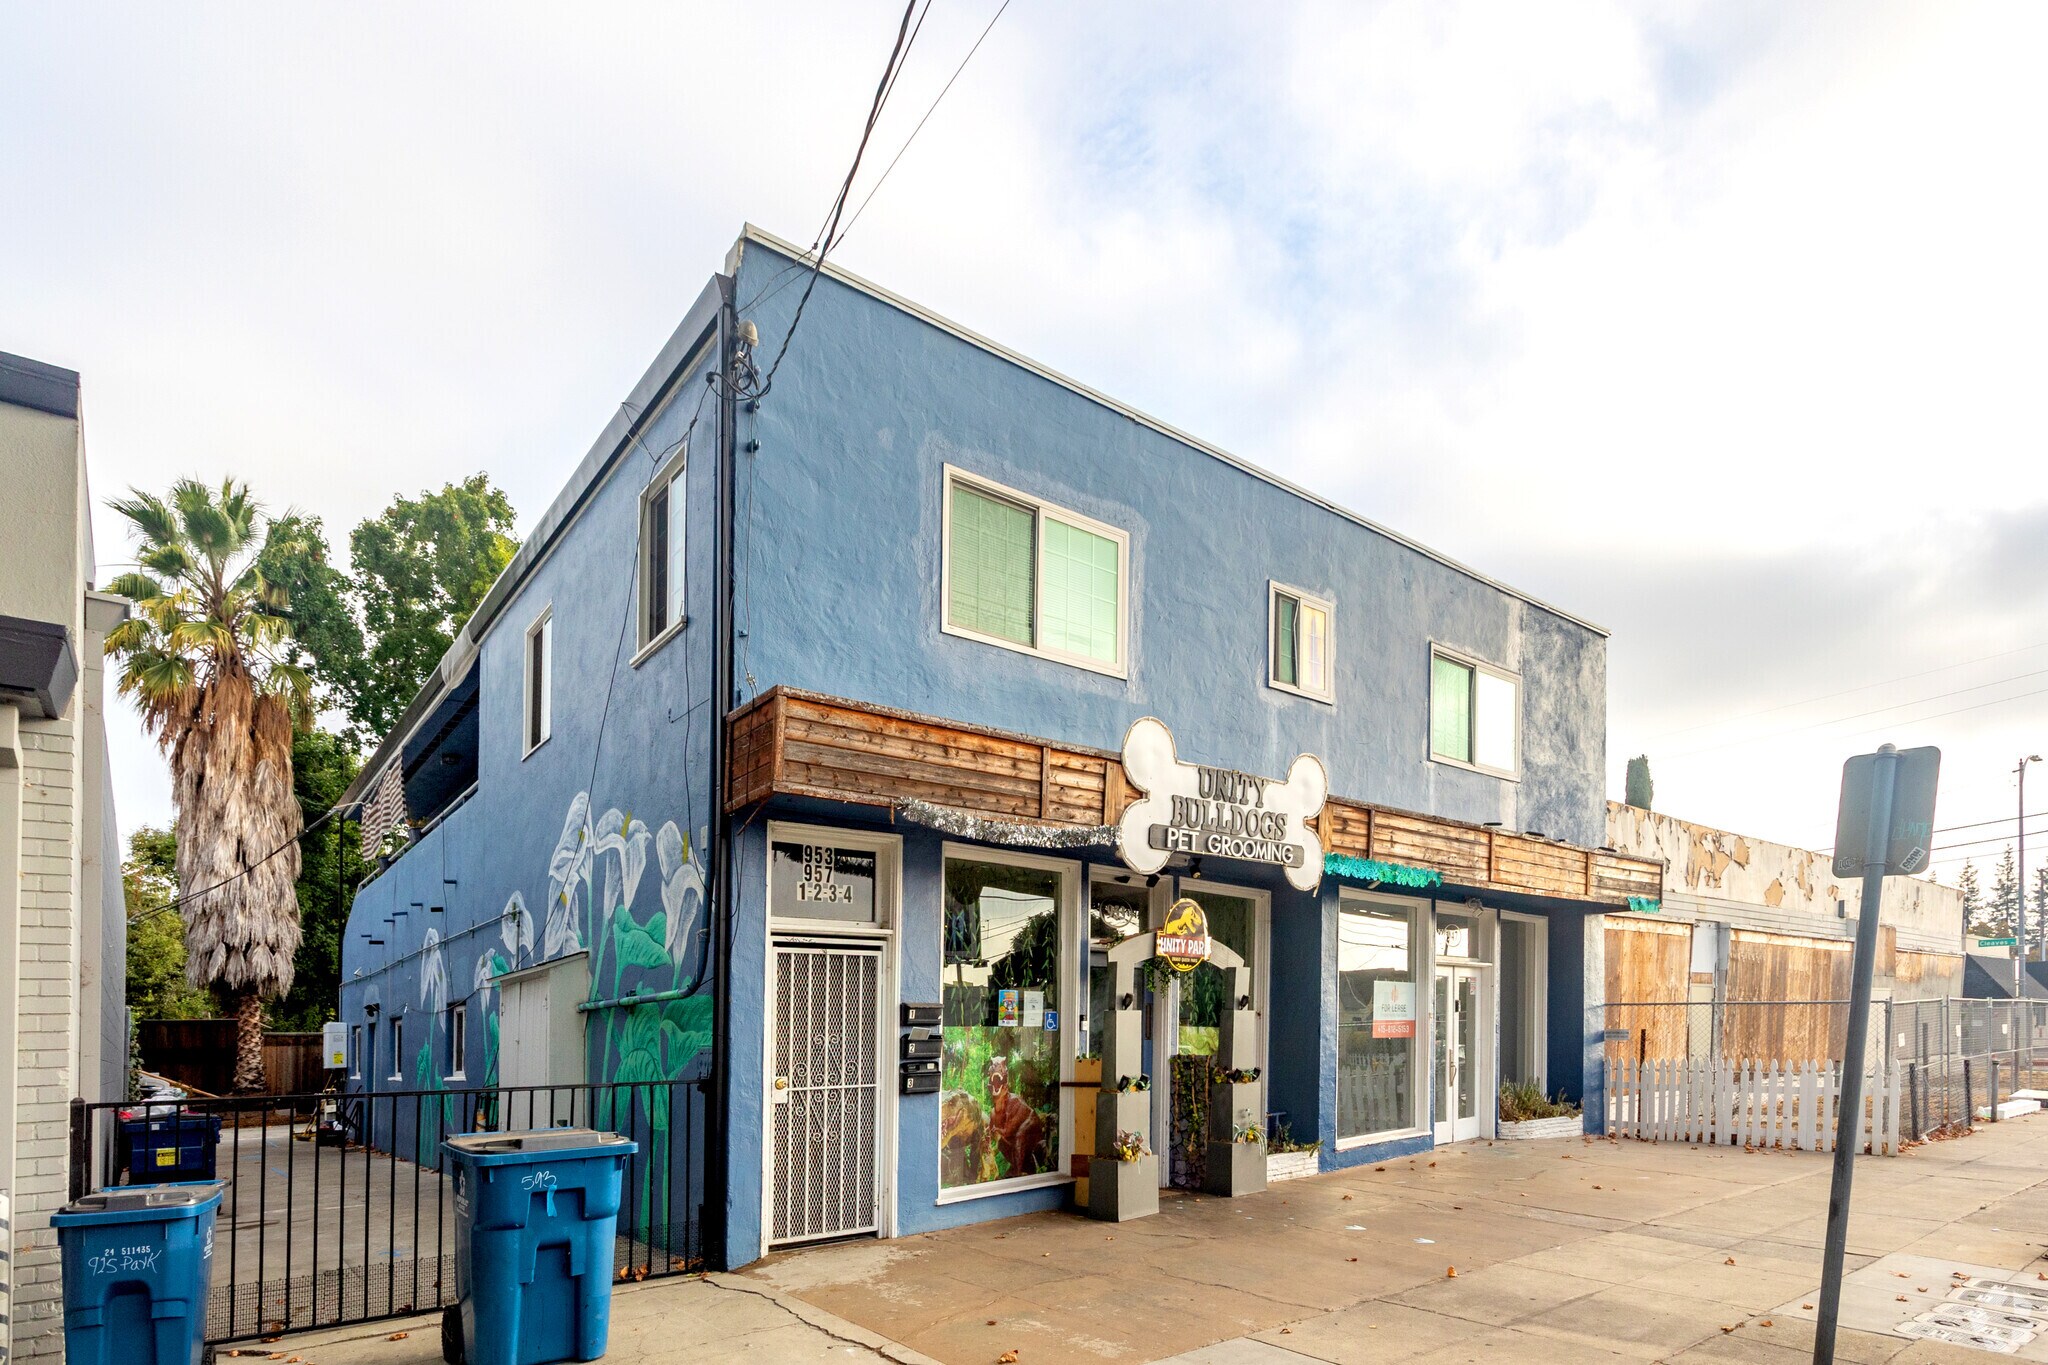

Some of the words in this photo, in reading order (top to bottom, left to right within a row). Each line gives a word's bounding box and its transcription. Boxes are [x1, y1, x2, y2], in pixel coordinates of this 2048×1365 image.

[1198, 767, 1269, 809] UNITY
[1171, 794, 1288, 842] BULLDOGS
[804, 844, 833, 866] 953
[1166, 827, 1200, 851] PET
[1207, 834, 1294, 865] GROOMING
[804, 864, 833, 883] 957
[1159, 935, 1187, 954] UNITY
[1382, 1003, 1391, 1013] FOR
[1392, 1003, 1407, 1013] LEASE
[521, 1170, 557, 1191] 593
[104, 1248, 115, 1257] 24
[121, 1245, 151, 1256] 511435
[120, 1249, 162, 1274] Park
